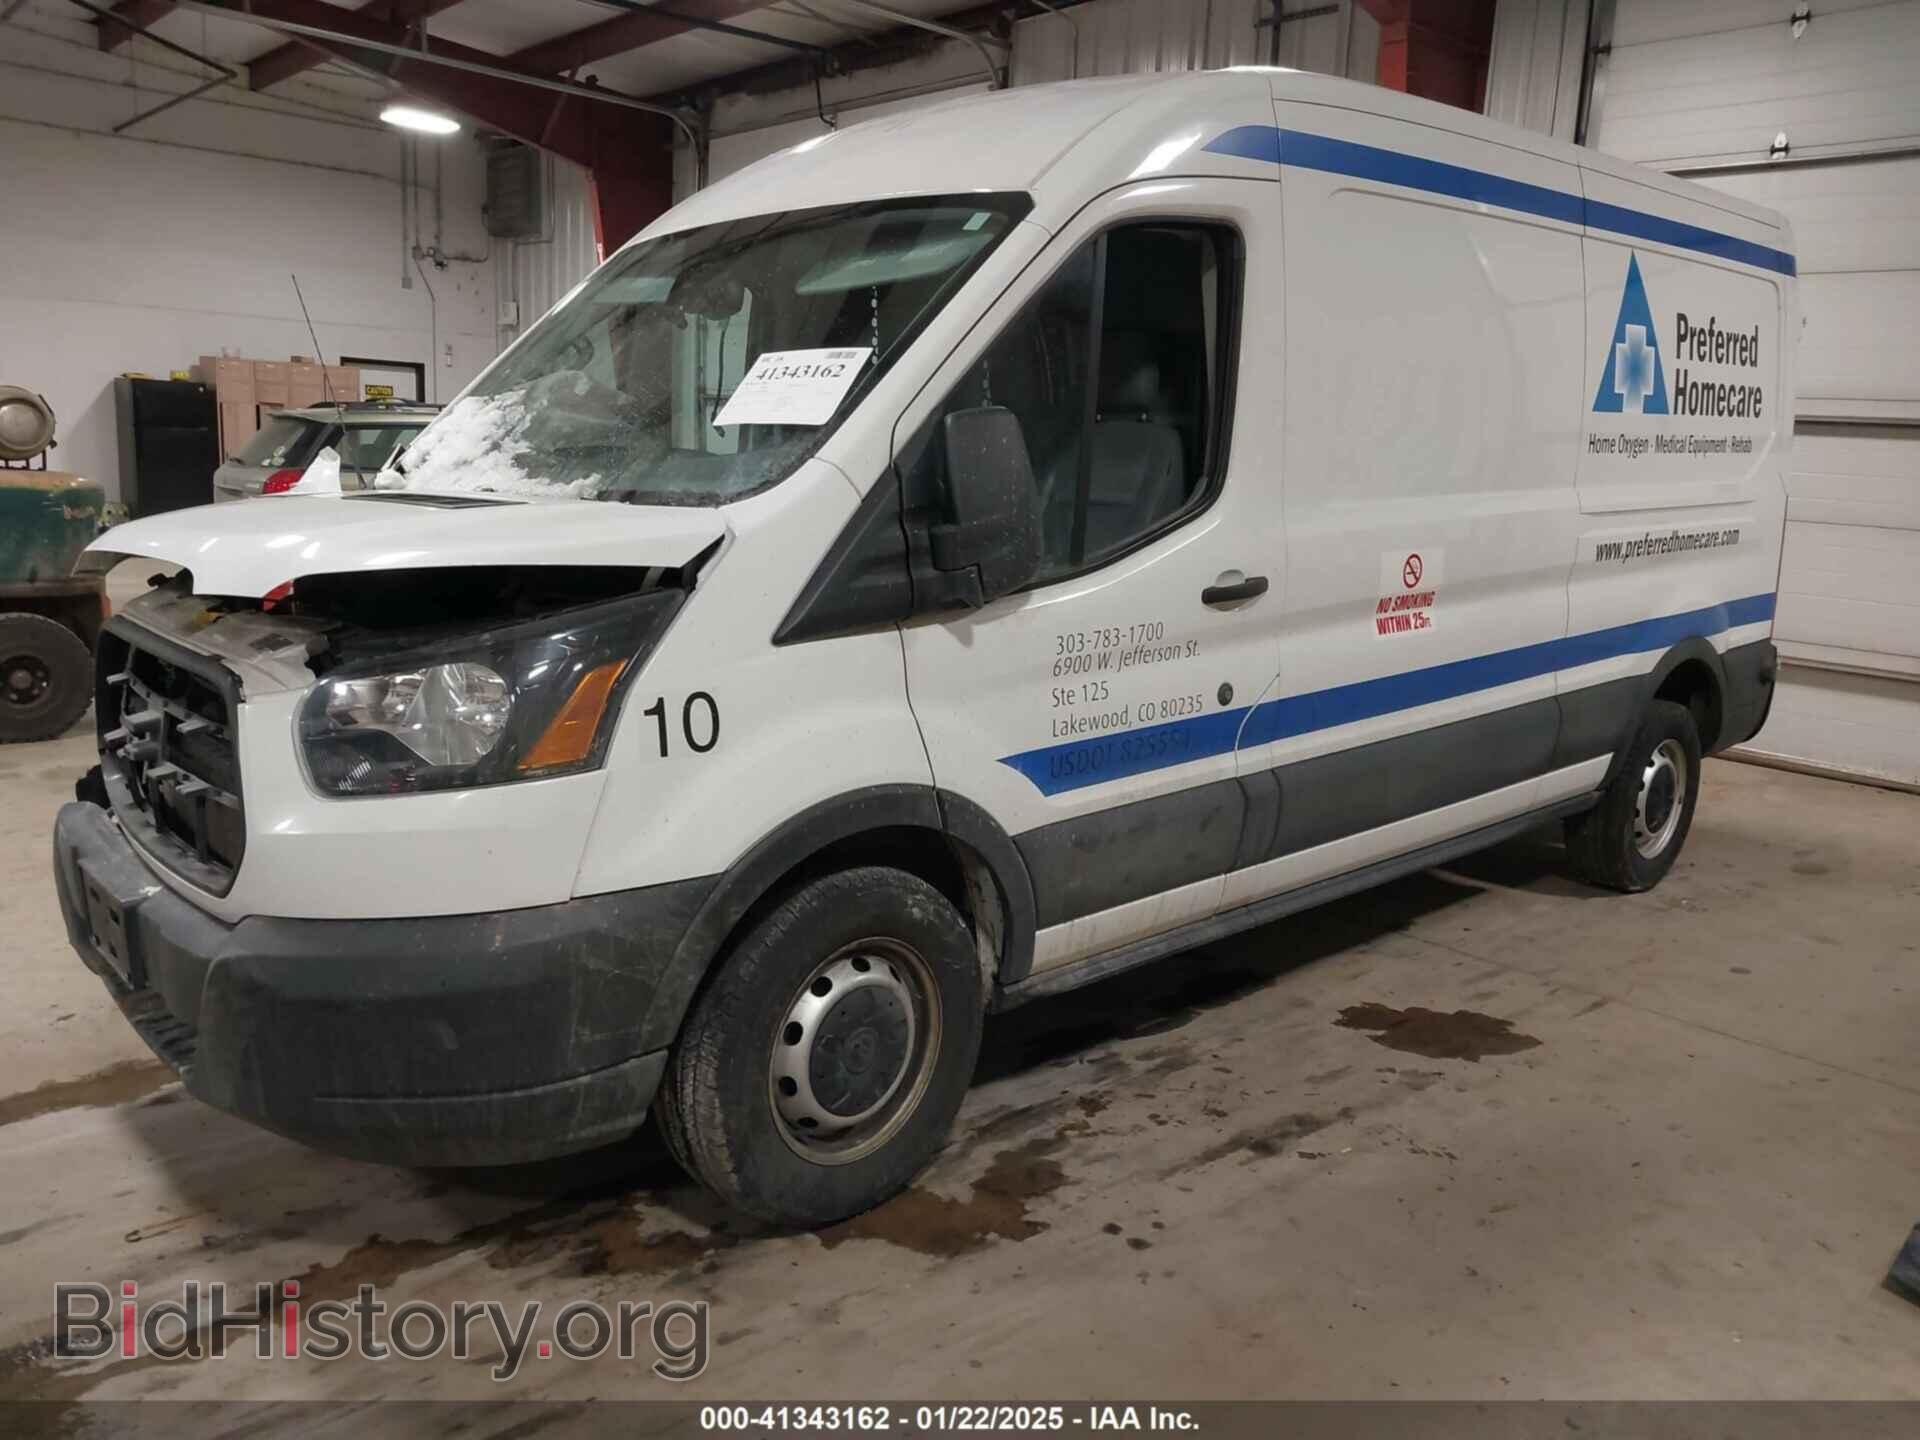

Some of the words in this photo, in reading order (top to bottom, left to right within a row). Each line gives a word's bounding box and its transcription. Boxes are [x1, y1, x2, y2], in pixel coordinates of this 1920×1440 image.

[1676, 312, 1759, 368] Preferred
[756, 363, 846, 380] 41343162
[1673, 368, 1762, 418] Homecare
[1588, 433, 1616, 454] Home
[1618, 433, 1649, 458] Oxygen
[1655, 434, 1687, 453] Medical
[1688, 434, 1727, 457] Equipment
[1596, 527, 1740, 564] www.preferredhomecare.com
[1376, 597, 1392, 614] NO
[1392, 591, 1436, 612] SMOKING
[1056, 622, 1164, 656] 303-783-1700
[1376, 614, 1412, 635] WITHIN
[1053, 653, 1092, 677] 6900
[1098, 649, 1114, 671] W.
[1117, 643, 1182, 673] Jefferson
[1185, 639, 1201, 658] St.
[1052, 688, 1076, 707] Ste
[1083, 681, 1109, 703] 125
[644, 691, 720, 757] 10
[1052, 704, 1133, 738] Lakewood,
[1138, 702, 1156, 722] CO
[1160, 694, 1203, 720] 80235
